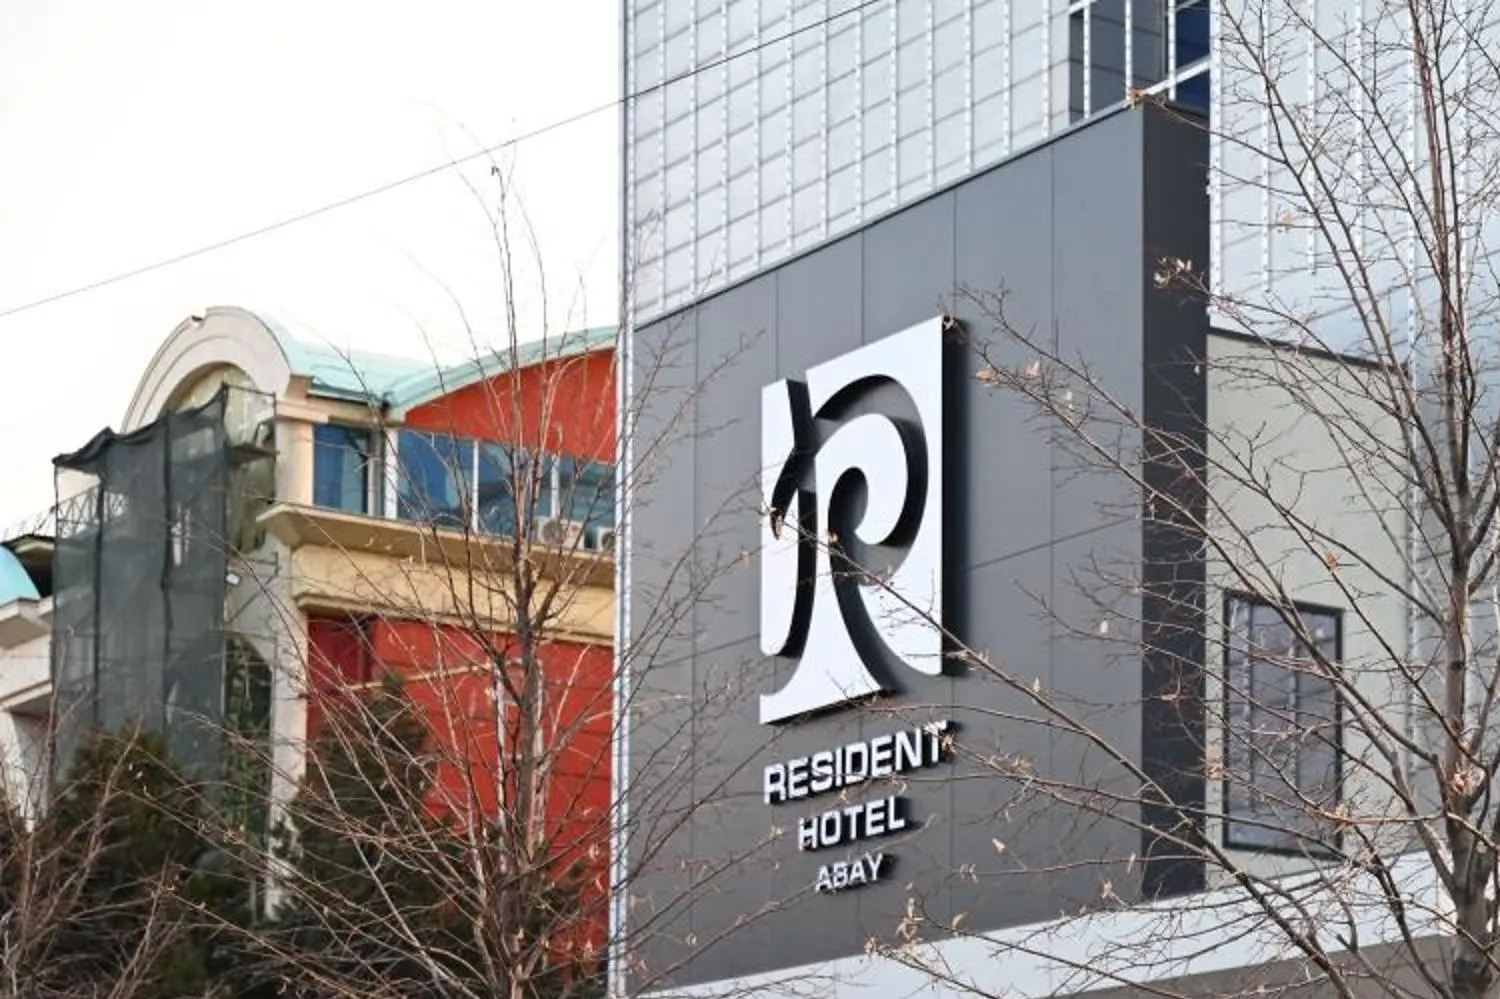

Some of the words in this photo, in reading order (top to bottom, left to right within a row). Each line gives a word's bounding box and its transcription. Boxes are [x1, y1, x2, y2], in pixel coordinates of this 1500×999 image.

[763, 719, 947, 804] RESIDENT
[798, 795, 905, 851] HOTEL
[815, 851, 883, 892] ABAY
